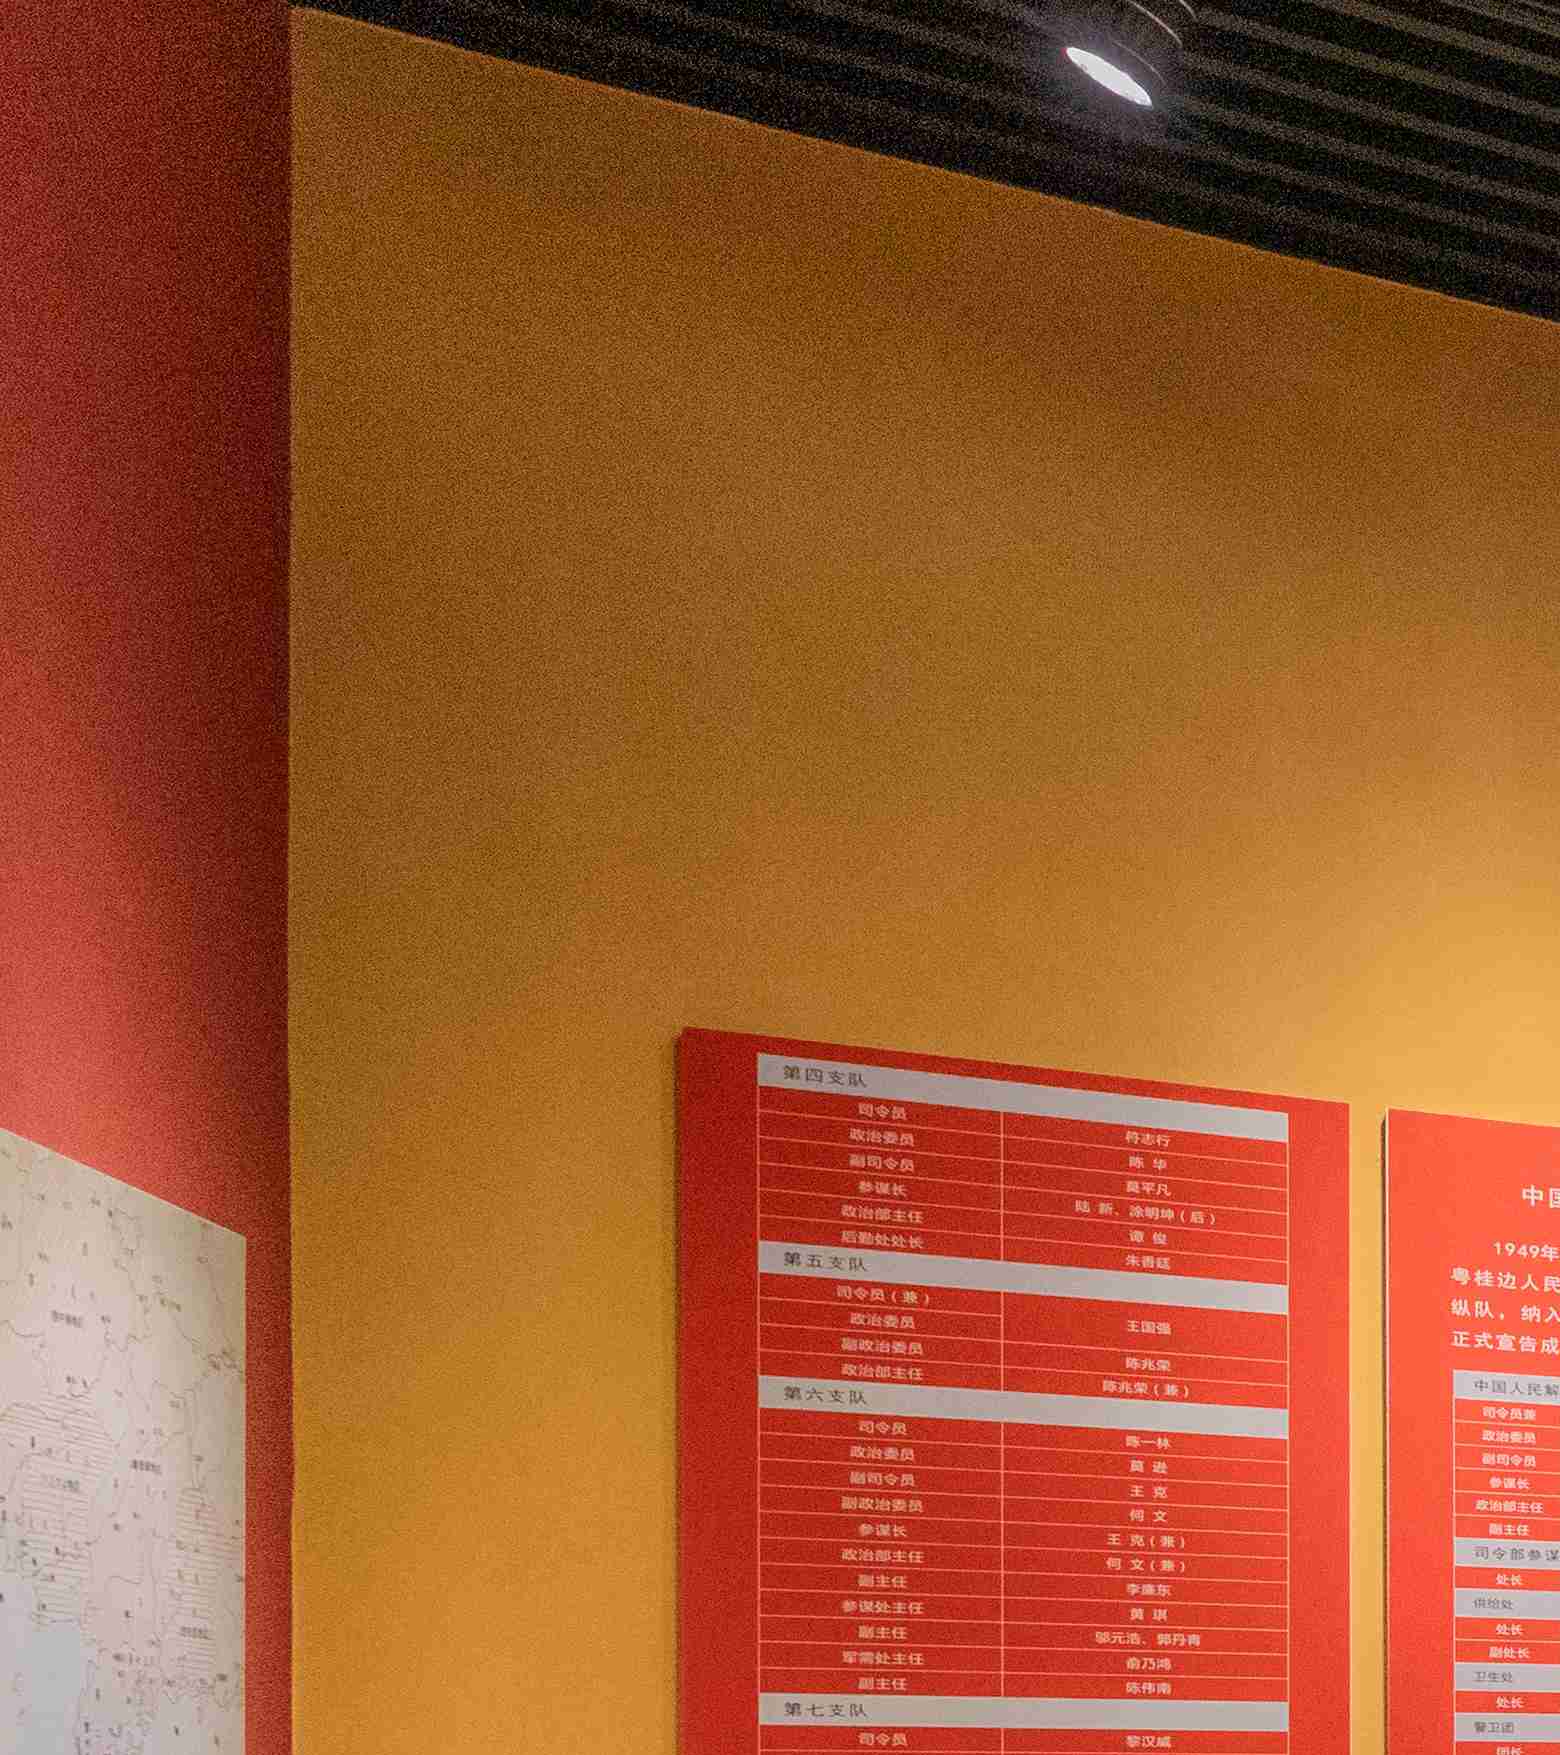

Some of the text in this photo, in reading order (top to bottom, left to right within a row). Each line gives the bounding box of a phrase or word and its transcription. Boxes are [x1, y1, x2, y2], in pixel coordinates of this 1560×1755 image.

[783, 1064, 867, 1090] 第四支队
[858, 1101, 907, 1121] 司令员
[849, 1126, 915, 1147] 政治委员
[849, 1152, 915, 1173] 副司令员
[858, 1179, 907, 1198] 参谋长
[841, 1203, 923, 1224] 政治部主任
[841, 1228, 923, 1249] 后勤处处长
[783, 1250, 867, 1274] 第五支队
[849, 1311, 915, 1330] 政治委员
[841, 1336, 923, 1356] 副政治委员
[841, 1361, 923, 1381] 政治部主任
[783, 1384, 867, 1406] 第六支队
[858, 1418, 907, 1435] 司令员
[1482, 1428, 1535, 1444] 政治委员
[849, 1444, 915, 1462] 政治委员
[849, 1470, 915, 1487] 副司令员
[841, 1495, 923, 1513] 副政治委员
[1476, 1498, 1543, 1514] 政治部主任
[858, 1521, 907, 1538] 参谋长
[1489, 1522, 1528, 1537] 副主任
[841, 1547, 923, 1564] 政治部主任
[858, 1573, 907, 1589] 副主任
[1495, 1572, 1522, 1586] 处长
[841, 1598, 923, 1615] 参谋处主任
[858, 1624, 907, 1640] 副主任
[1495, 1623, 1522, 1636] 处长
[1489, 1646, 1529, 1660] 副处长
[858, 1675, 907, 1690] 副主任
[783, 1701, 867, 1719] 第七支队
[1496, 1696, 1522, 1709] 处长
[858, 1732, 907, 1746] 司令员
